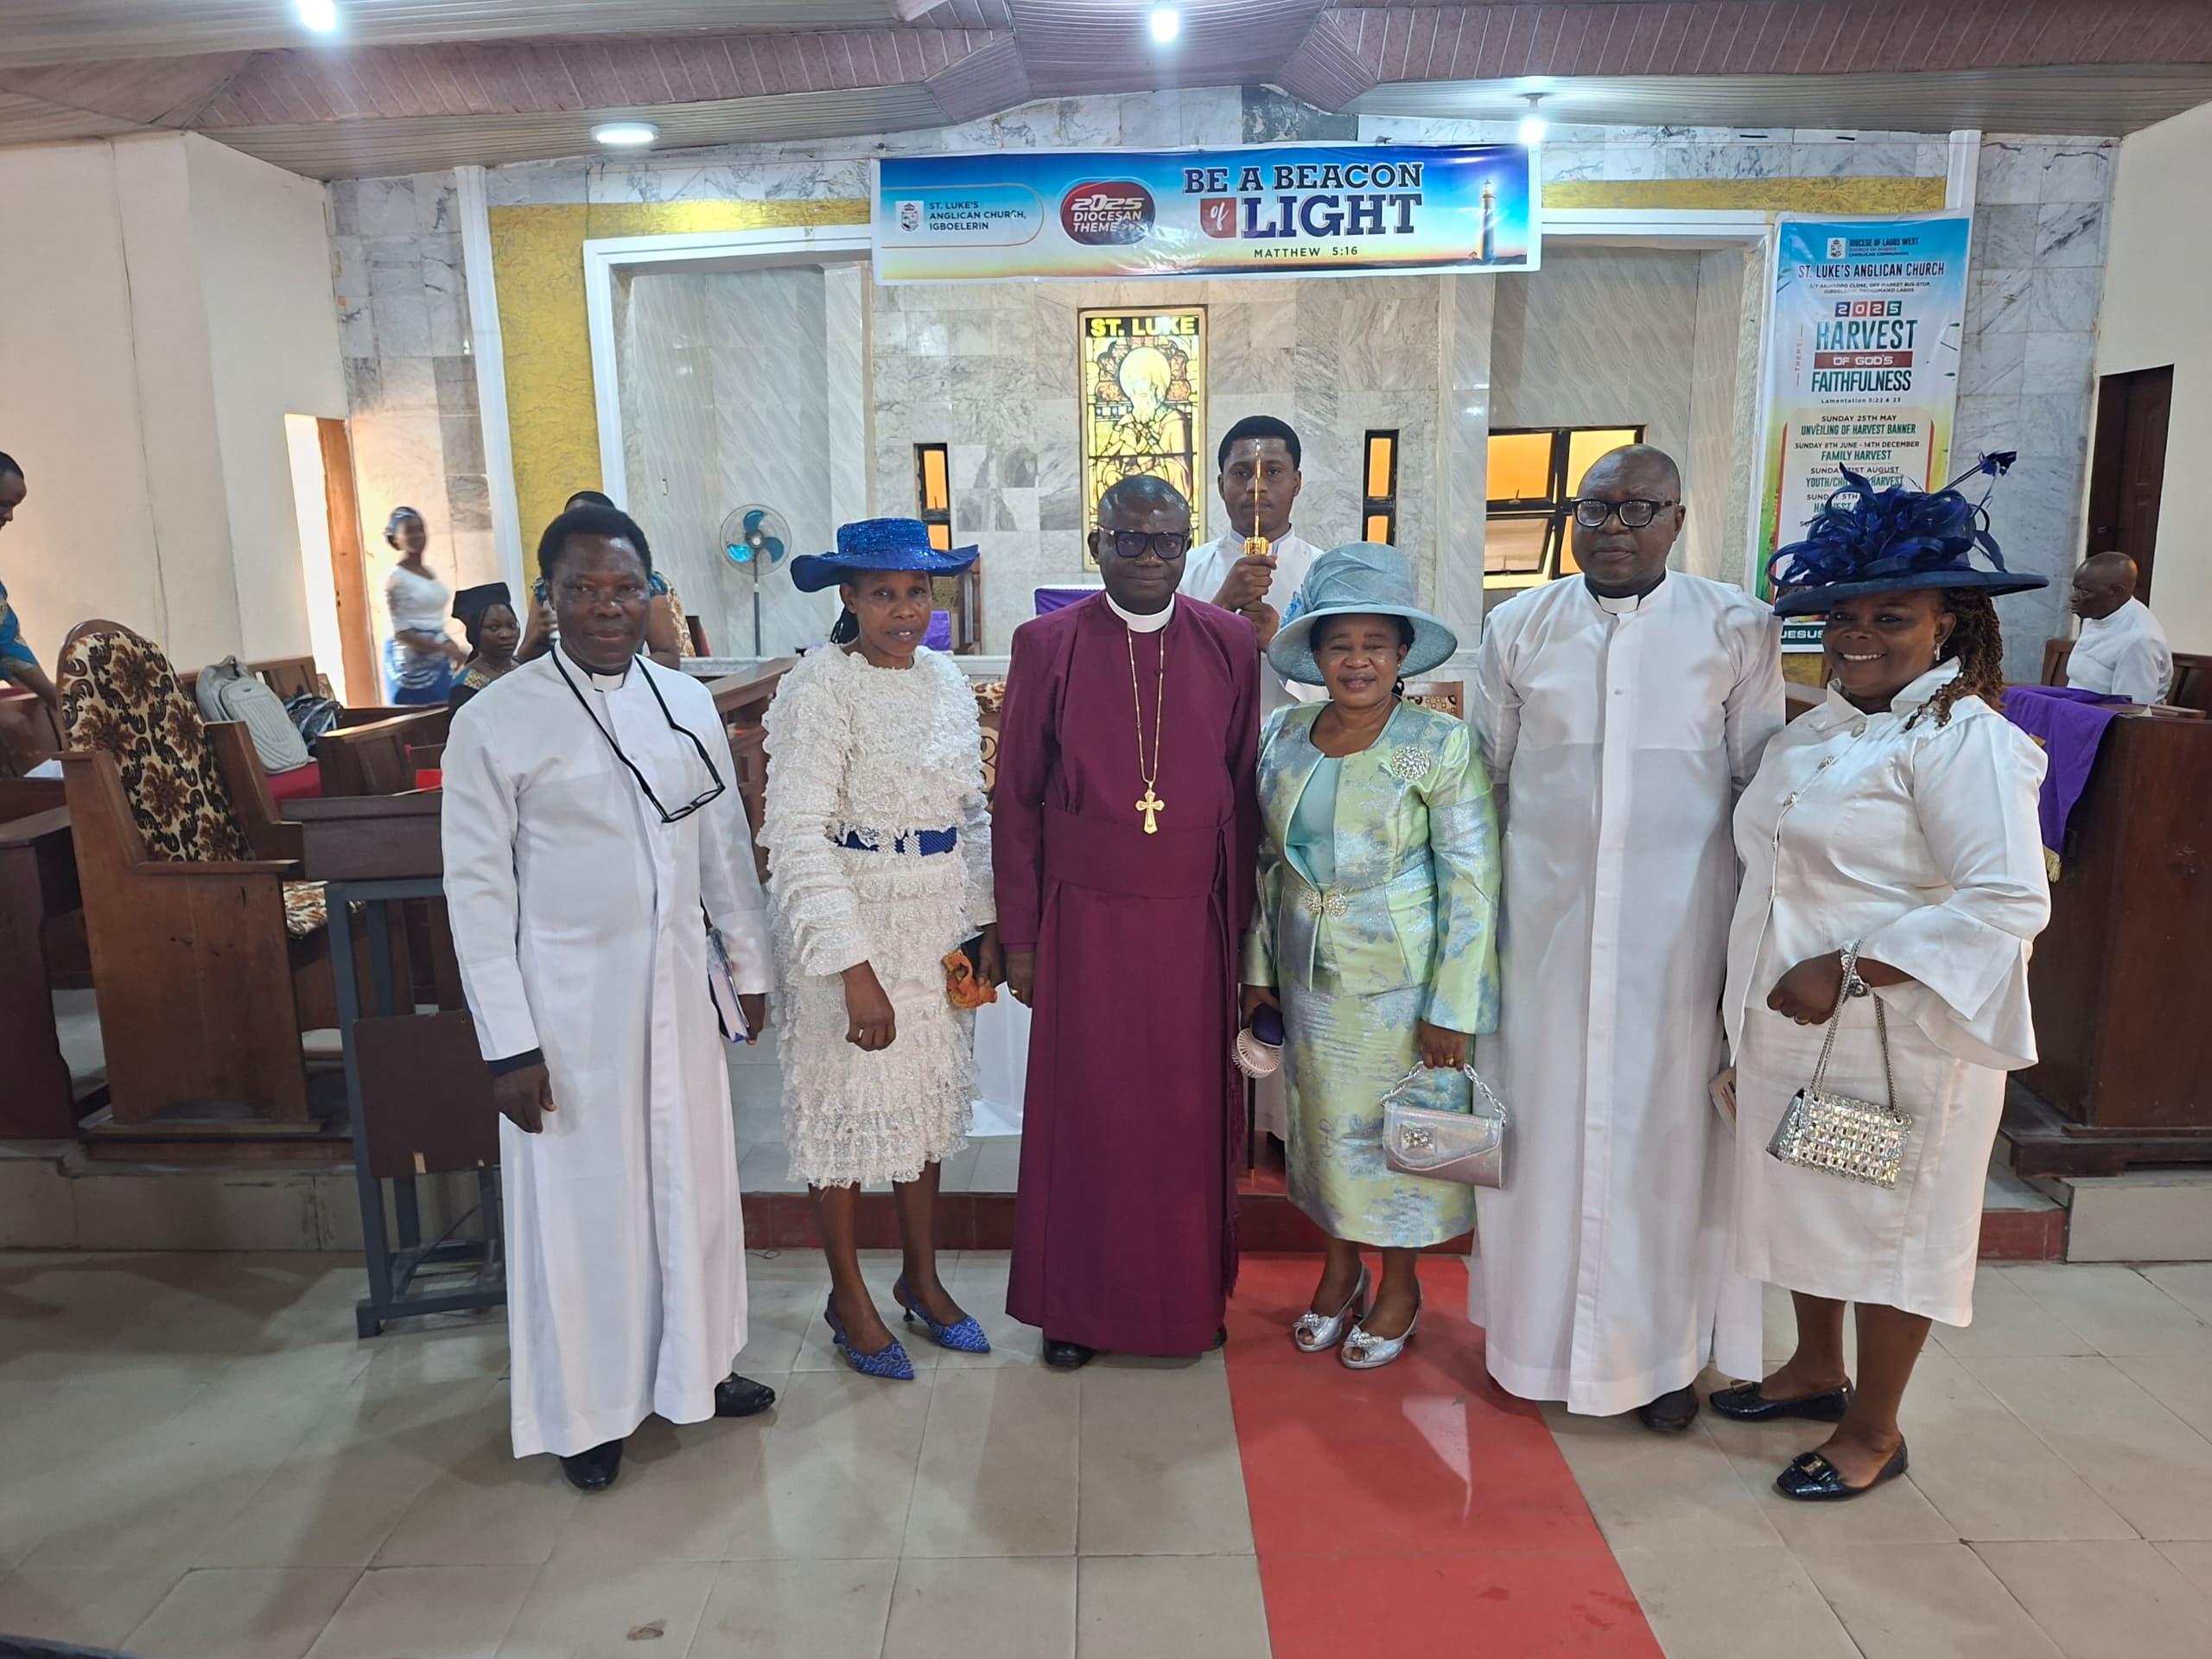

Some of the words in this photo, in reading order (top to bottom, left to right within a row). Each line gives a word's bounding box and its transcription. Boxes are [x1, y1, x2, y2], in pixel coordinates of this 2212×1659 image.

[1183, 168, 1228, 194] BE
[1237, 167, 1263, 191] A
[1272, 162, 1424, 189] BEACON
[1071, 194, 1145, 211] 2025
[929, 211, 982, 219] ANGLICAN
[1073, 211, 1142, 222] DIOCESAN
[1210, 201, 1229, 231] of
[1242, 193, 1422, 238] LIGHT
[930, 221, 988, 231] IGBOELERIN
[1073, 222, 1117, 232] THEME
[1902, 237, 1919, 245] WEST
[1254, 248, 1320, 258] MATTHEW
[1332, 246, 1358, 256] 5:16
[1798, 265, 1812, 278] ST.
[1816, 264, 1850, 277] LUKE'S
[1853, 264, 1903, 276] ANGLICAN
[1906, 263, 1945, 276] CHURCH
[1837, 302, 1900, 315] 2025
[1090, 318, 1125, 336] ST.
[1133, 318, 1196, 336] LUKE
[1815, 320, 1917, 350] HARVEST
[1833, 357, 1850, 365] OF
[1855, 355, 1893, 365] GOD'S
[1811, 370, 1912, 392] FAITHFULNESS
[1801, 424, 1840, 435] UNVEILING
[1841, 425, 1851, 435] OF
[1853, 424, 1885, 435] HARVEST
[1887, 423, 1916, 434] BANNER
[1821, 450, 1852, 461] FAMILY
[1854, 450, 1892, 461] HARVEST
